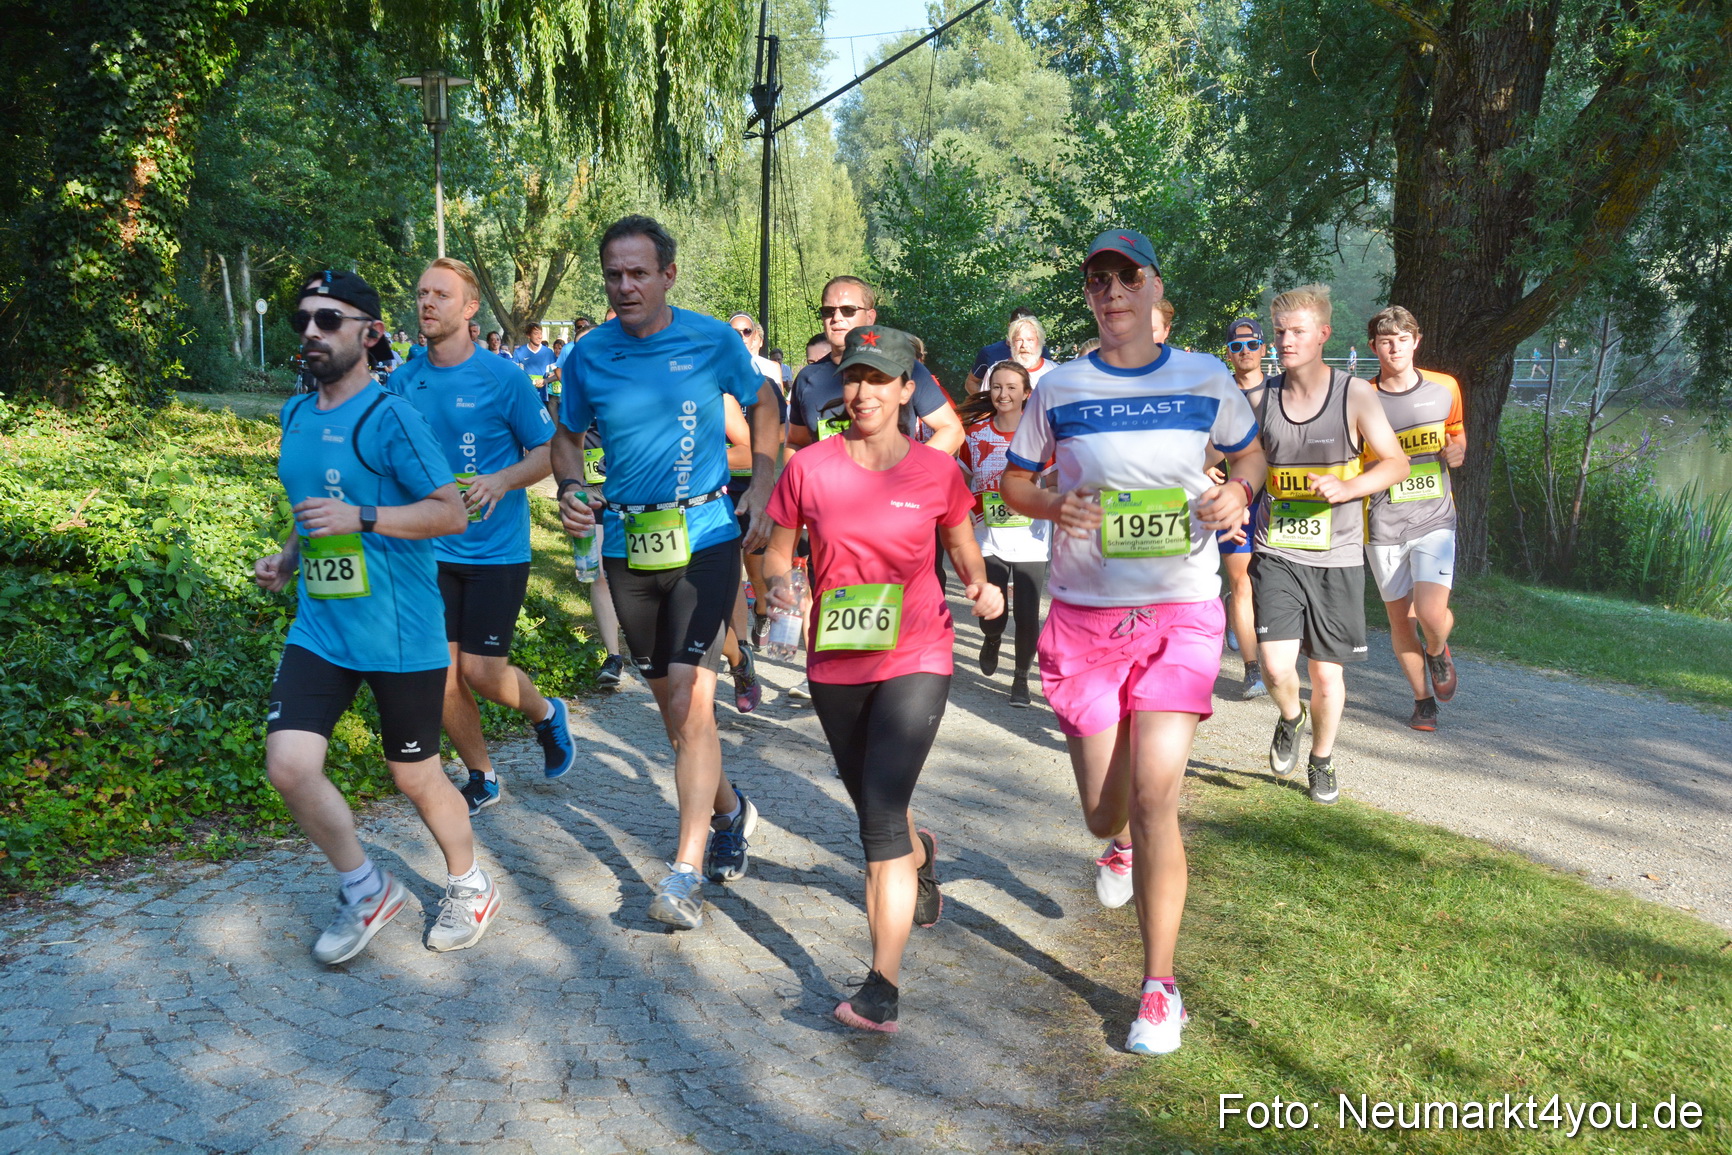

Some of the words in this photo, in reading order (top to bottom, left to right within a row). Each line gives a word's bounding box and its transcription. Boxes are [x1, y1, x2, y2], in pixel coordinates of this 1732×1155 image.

[1110, 400, 1186, 417] PLAST
[1112, 419, 1159, 427] GROUP
[1397, 475, 1435, 493] 1386
[1113, 512, 1179, 538] 1957
[1276, 517, 1321, 536] 1383
[628, 530, 677, 554] 2131
[304, 557, 354, 581] 2128
[826, 607, 890, 632] 2066
